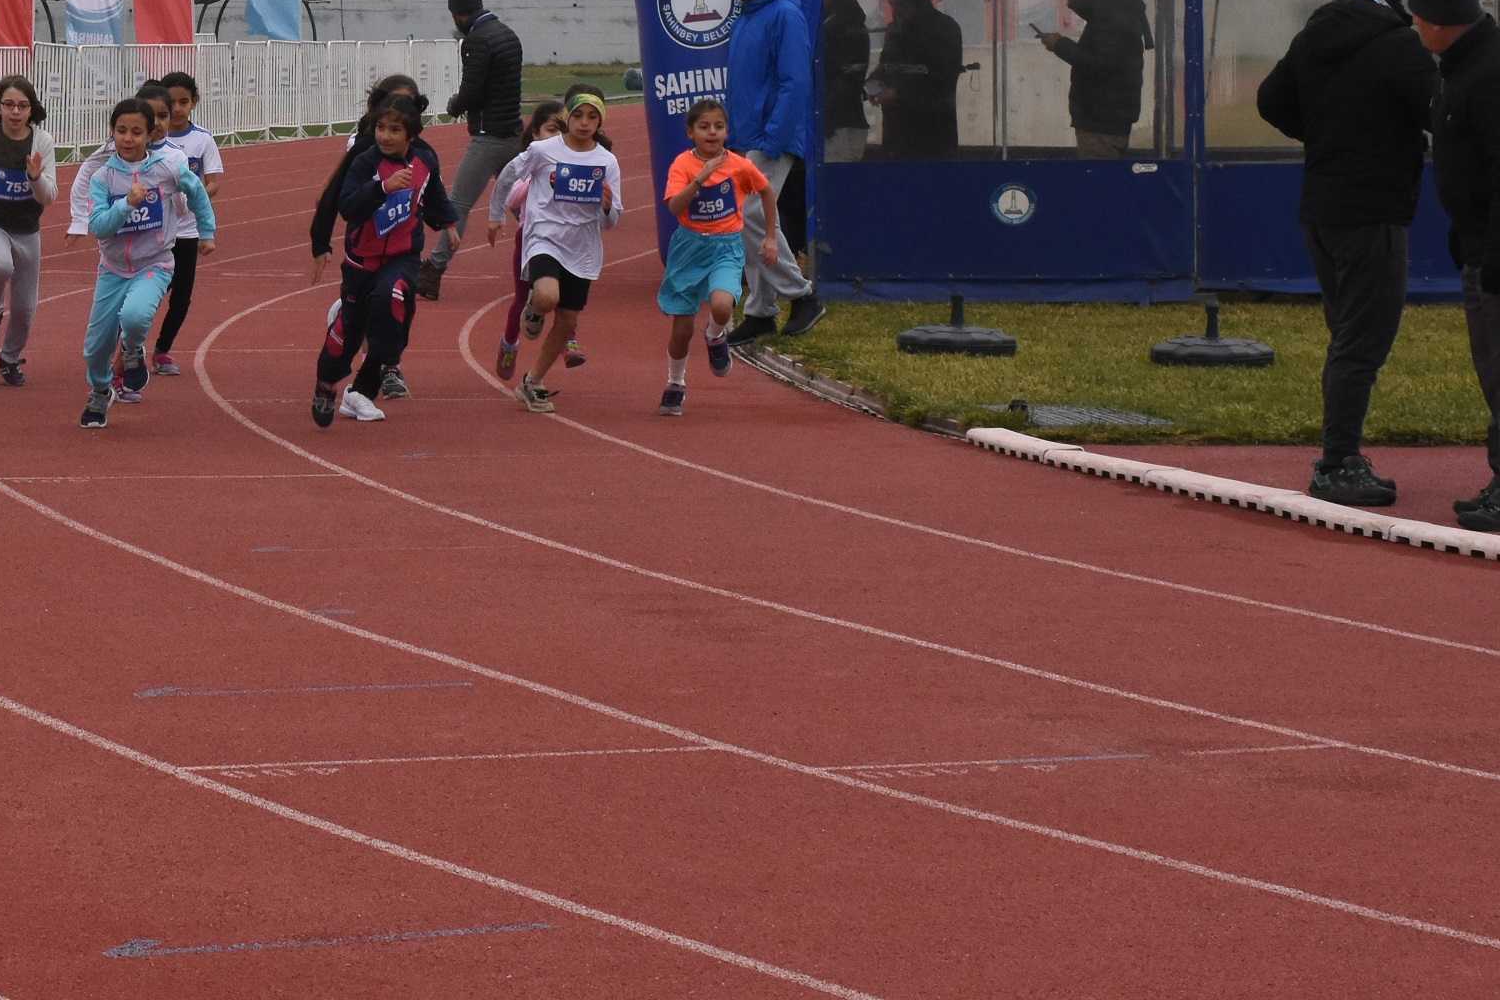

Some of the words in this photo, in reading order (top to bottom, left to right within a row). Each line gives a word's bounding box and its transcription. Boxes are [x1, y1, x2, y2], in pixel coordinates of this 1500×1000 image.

[663, 4, 698, 43] ŞAHİNBEY
[655, 67, 728, 101] ŞAHİN
[5, 180, 30, 193] 753
[568, 177, 595, 192] 957
[698, 198, 724, 213] 259
